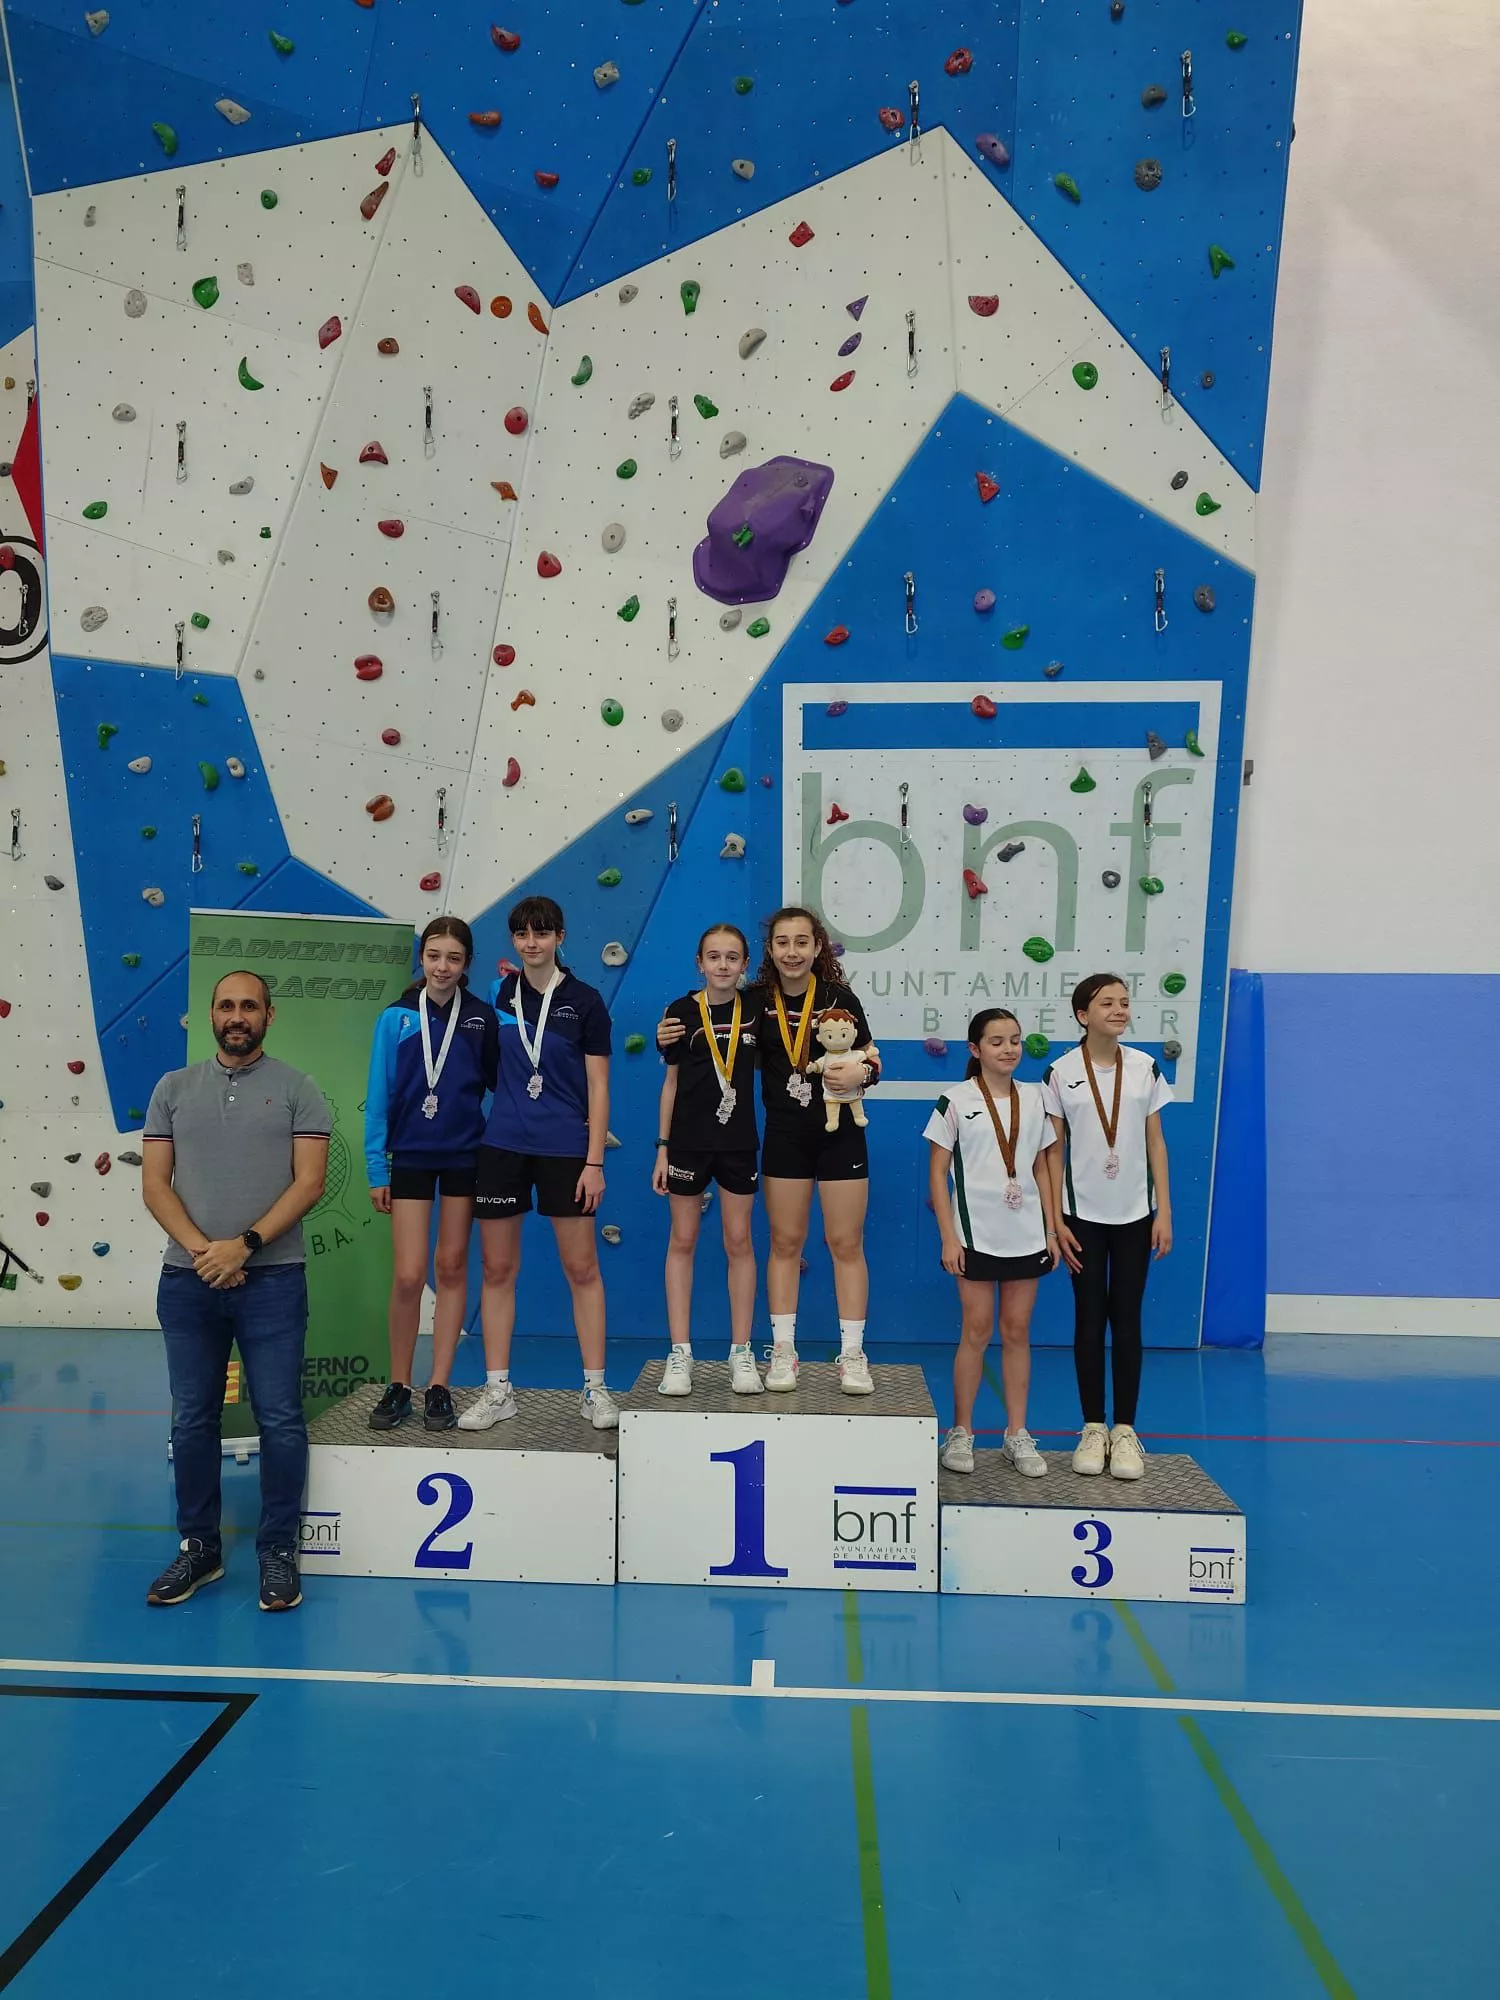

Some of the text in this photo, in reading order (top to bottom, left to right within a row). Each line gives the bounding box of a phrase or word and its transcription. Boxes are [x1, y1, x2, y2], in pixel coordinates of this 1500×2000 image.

[801, 767, 1196, 954] bnf
[191, 936, 414, 966] BADMINTON
[260, 975, 386, 1001] RAGON
[476, 1196, 516, 1204] GIVOVA
[303, 1355, 369, 1377] ERNO
[415, 1473, 473, 1569] 2
[709, 1440, 788, 1576] 1
[834, 1499, 916, 1543] bnf
[299, 1519, 341, 1541] bnf
[833, 1552, 849, 1560] DE
[834, 1546, 917, 1554] AYUNTAMIENTO
[1071, 1520, 1114, 1587] 3
[1189, 1554, 1235, 1580] bnf
